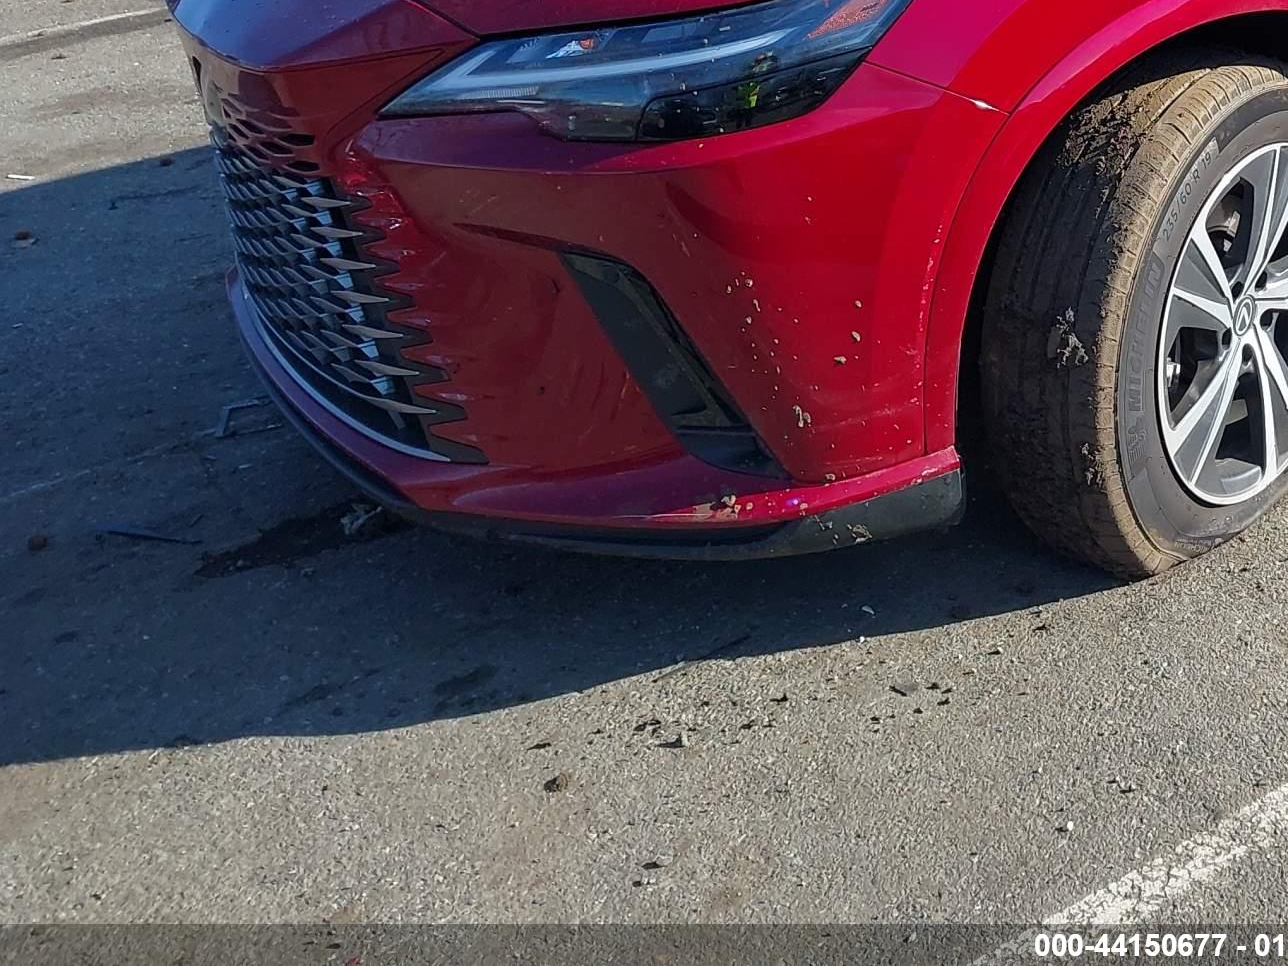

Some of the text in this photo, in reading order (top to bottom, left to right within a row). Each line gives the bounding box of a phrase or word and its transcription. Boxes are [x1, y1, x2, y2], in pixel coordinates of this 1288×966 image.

[1162, 151, 1212, 242] 235/60 R 19
[1128, 261, 1163, 413] MICHELIN
